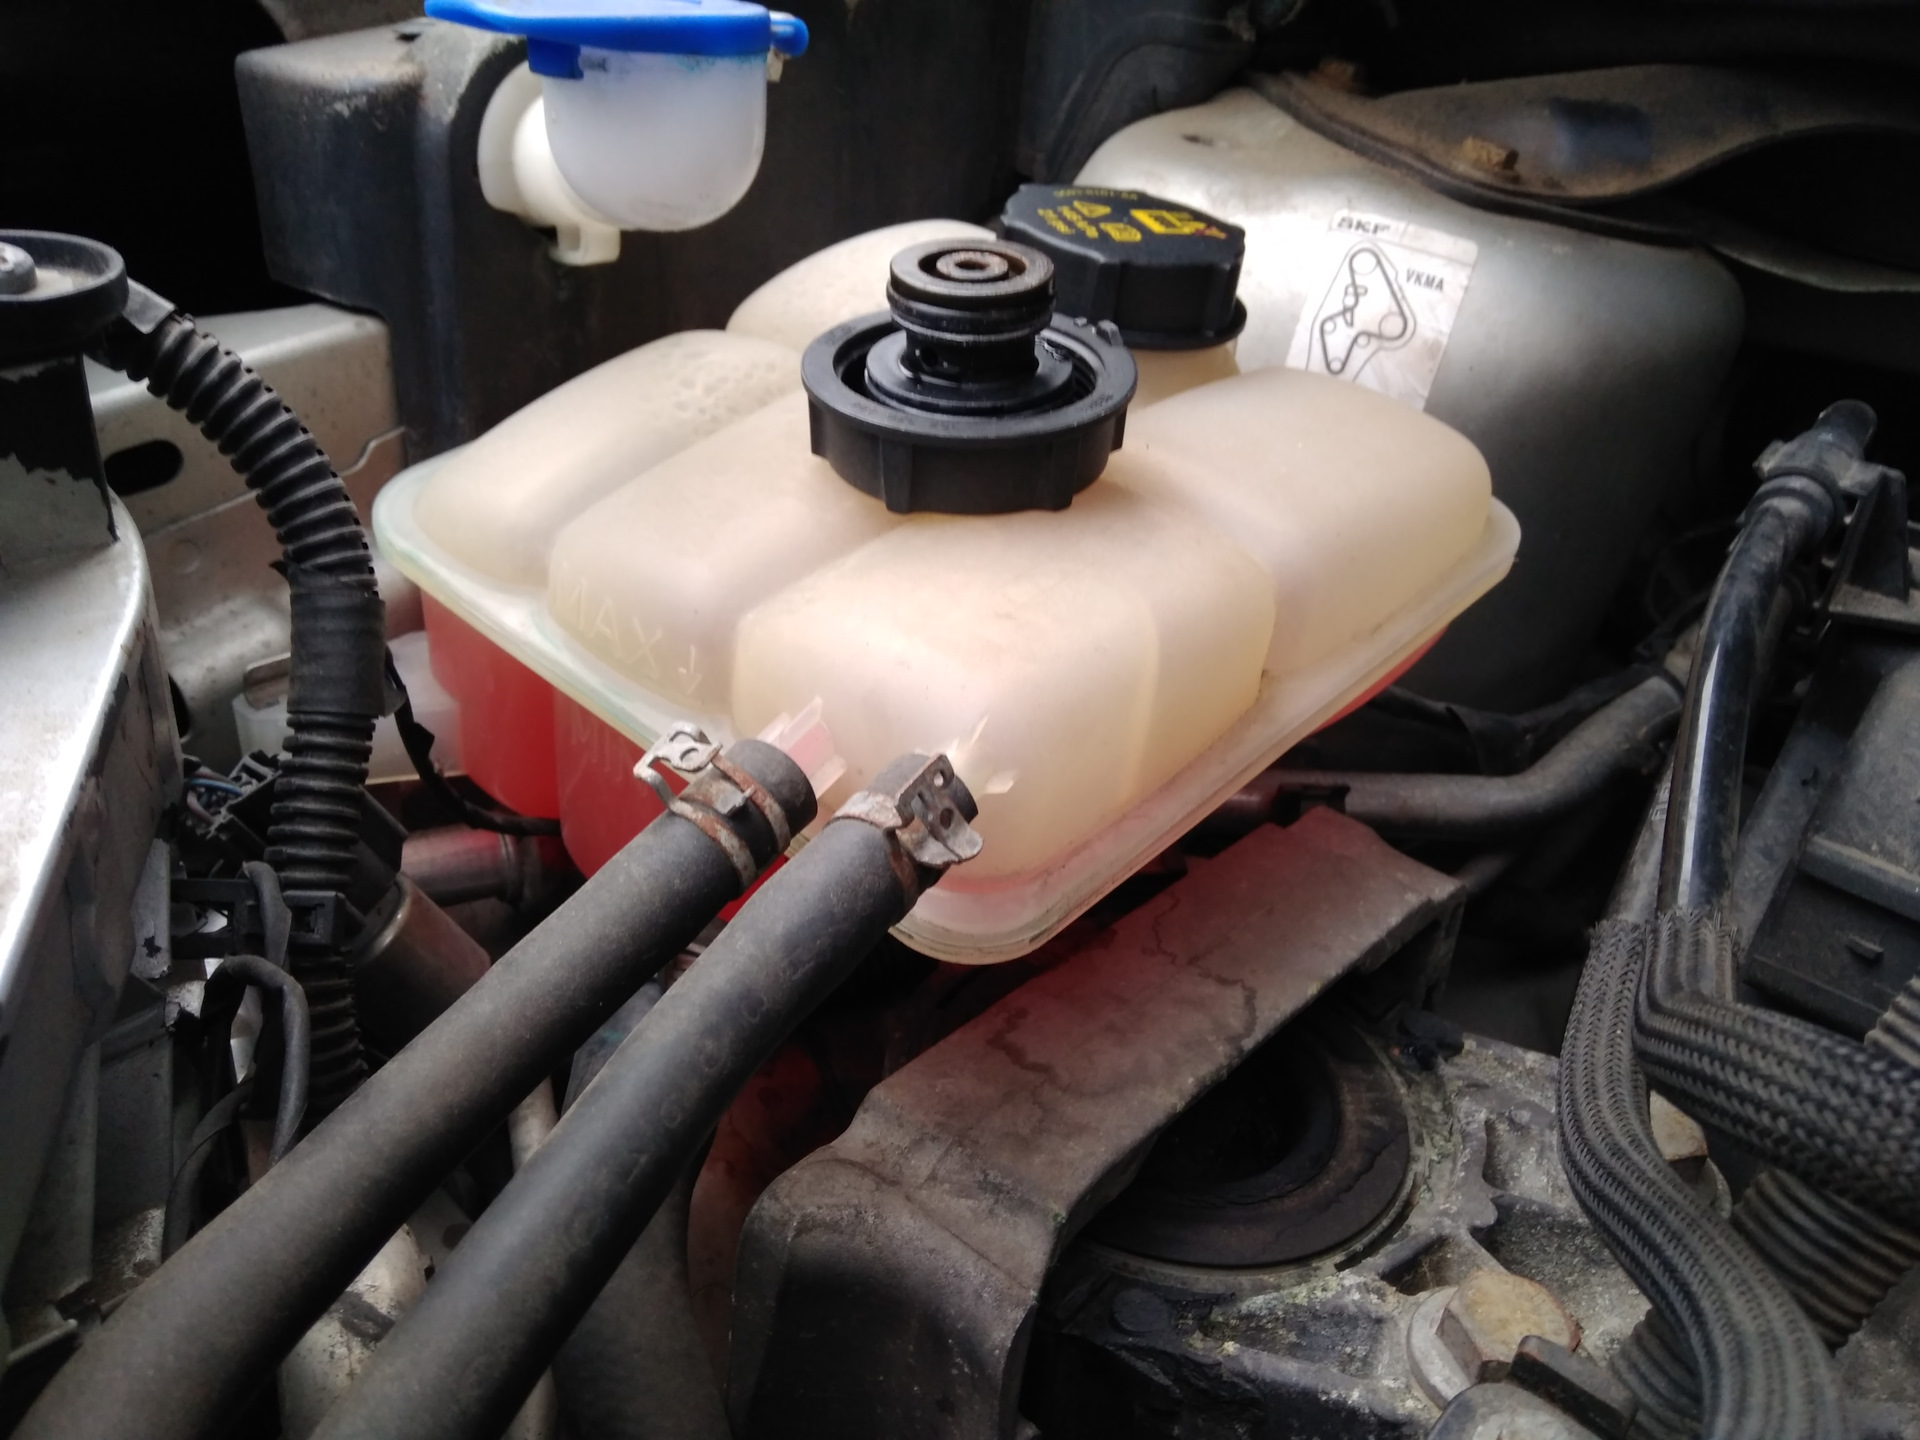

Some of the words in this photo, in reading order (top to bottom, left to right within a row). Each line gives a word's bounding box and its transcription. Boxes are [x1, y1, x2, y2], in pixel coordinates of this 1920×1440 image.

[1337, 216, 1390, 236] SKF
[1405, 268, 1445, 292] VKMA
[554, 560, 664, 681] MAX
